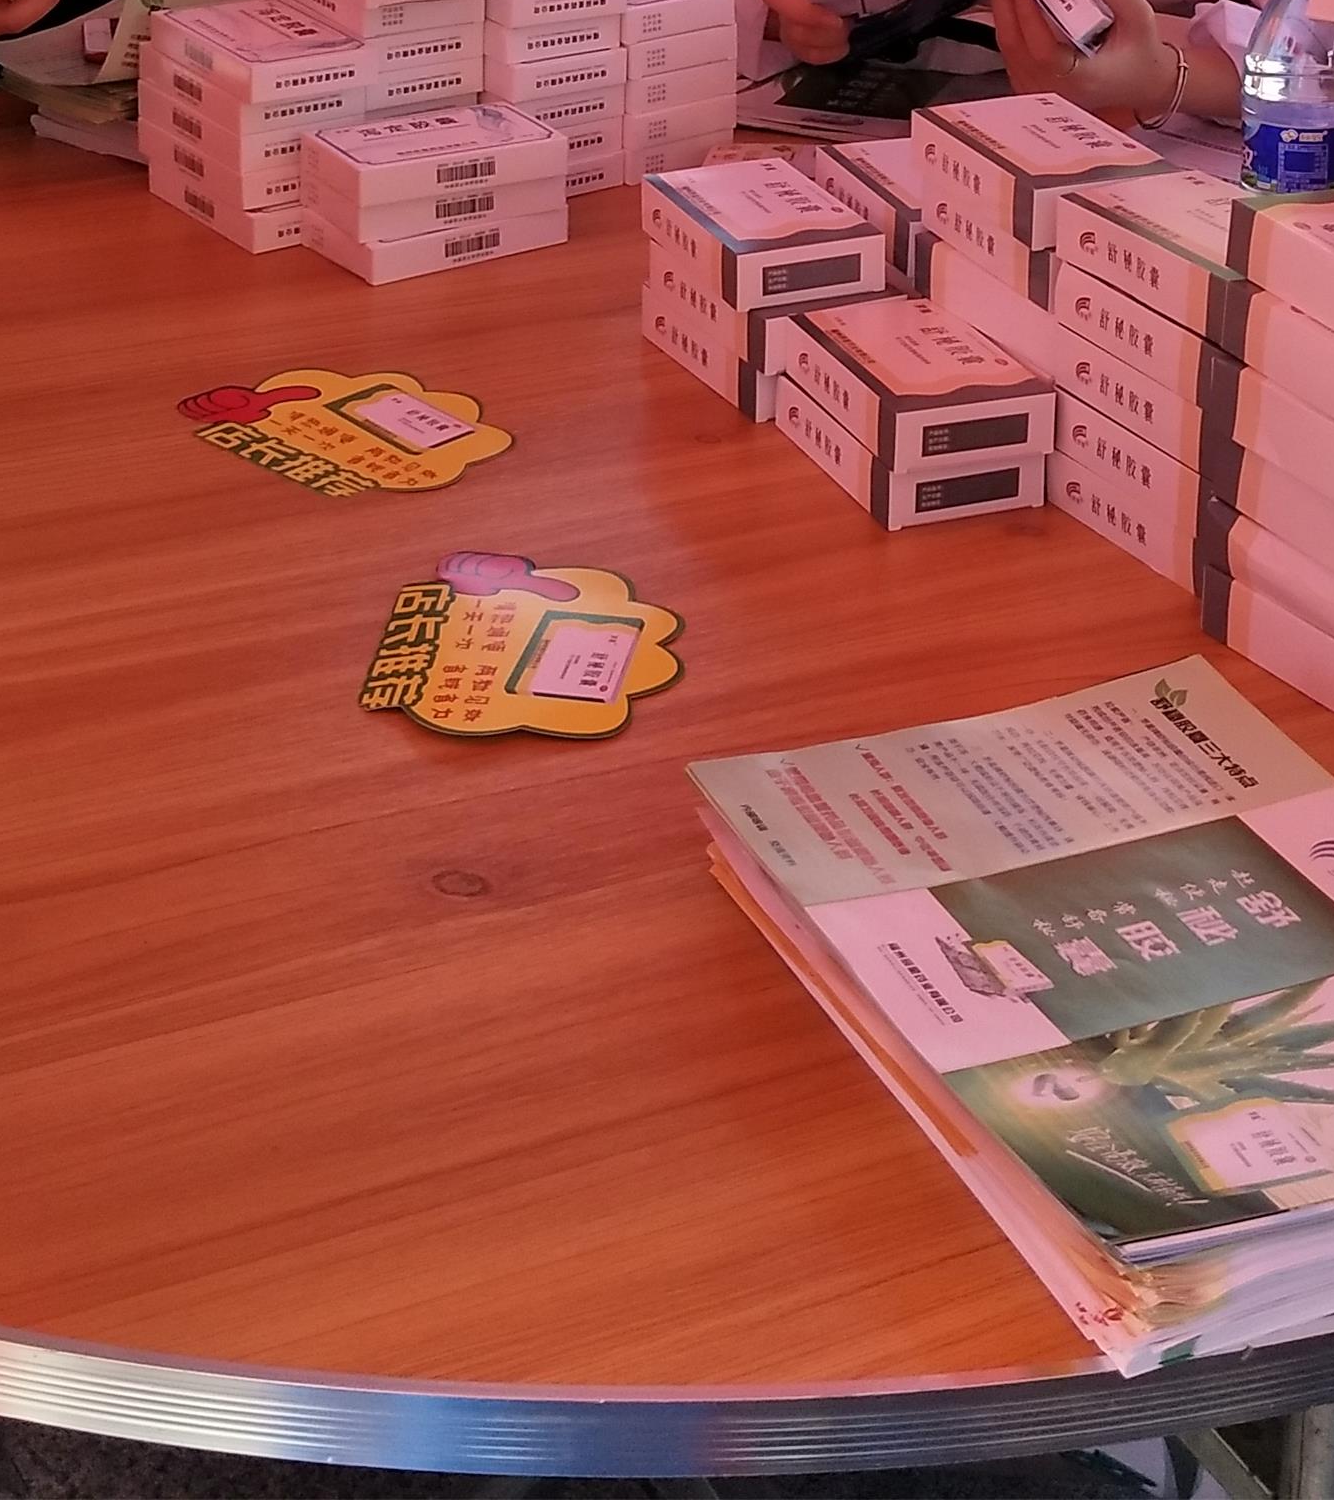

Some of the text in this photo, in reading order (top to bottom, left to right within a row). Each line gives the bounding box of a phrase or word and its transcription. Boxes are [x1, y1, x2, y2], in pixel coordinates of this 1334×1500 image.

[1105, 239, 1161, 291] 舒秘胶囊
[1097, 307, 1155, 359] 舒秘胶囊
[1098, 372, 1155, 426] 舒秘胶囊
[196, 422, 382, 498] 店长推荐
[270, 418, 336, 451] 一天一次
[1095, 438, 1153, 491] 舒秘胶囊
[1090, 493, 1148, 546] 舒秘胶囊
[361, 583, 454, 711] 店长推荐
[455, 598, 485, 652] 一天一次
[1053, 889, 1303, 978] 舒秘胶囊
